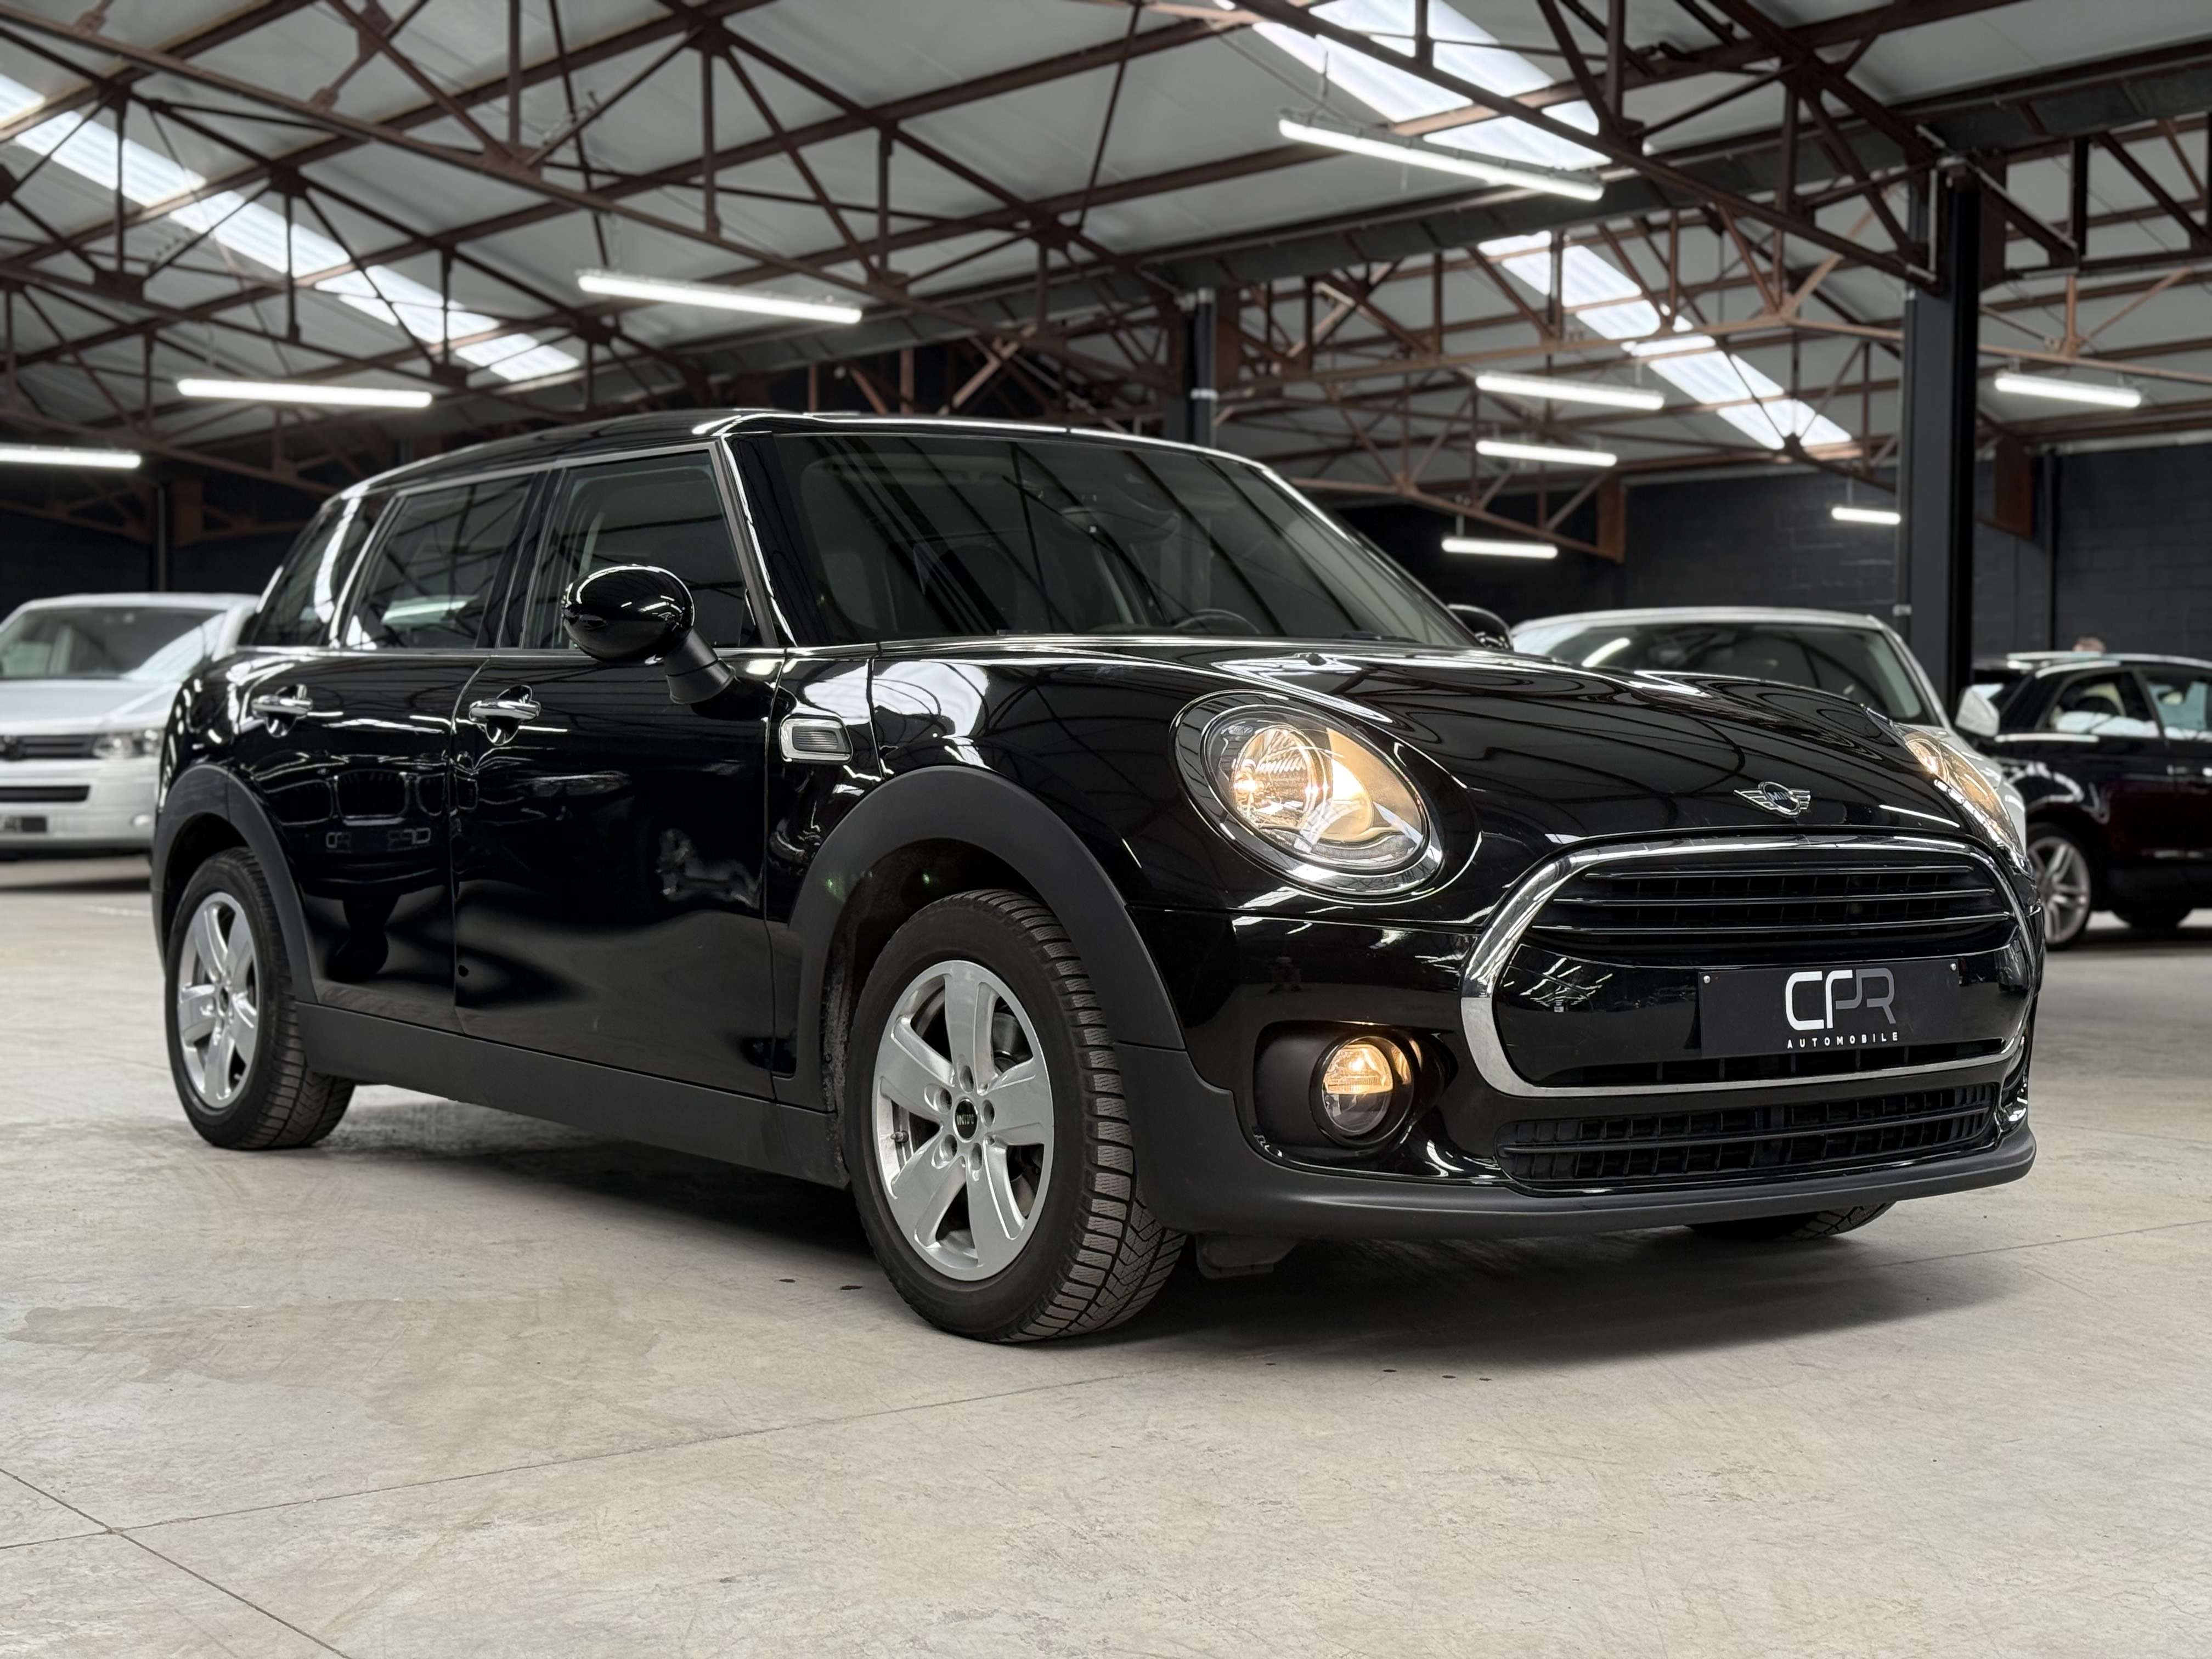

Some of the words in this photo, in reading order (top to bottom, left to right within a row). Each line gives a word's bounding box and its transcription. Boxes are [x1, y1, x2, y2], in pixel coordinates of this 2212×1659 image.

[1767, 792, 1790, 800] MIN
[1785, 968, 1896, 1031] CPR
[1787, 1032, 1898, 1049] AUTOMOBILE
[957, 1114, 974, 1125] MINI
